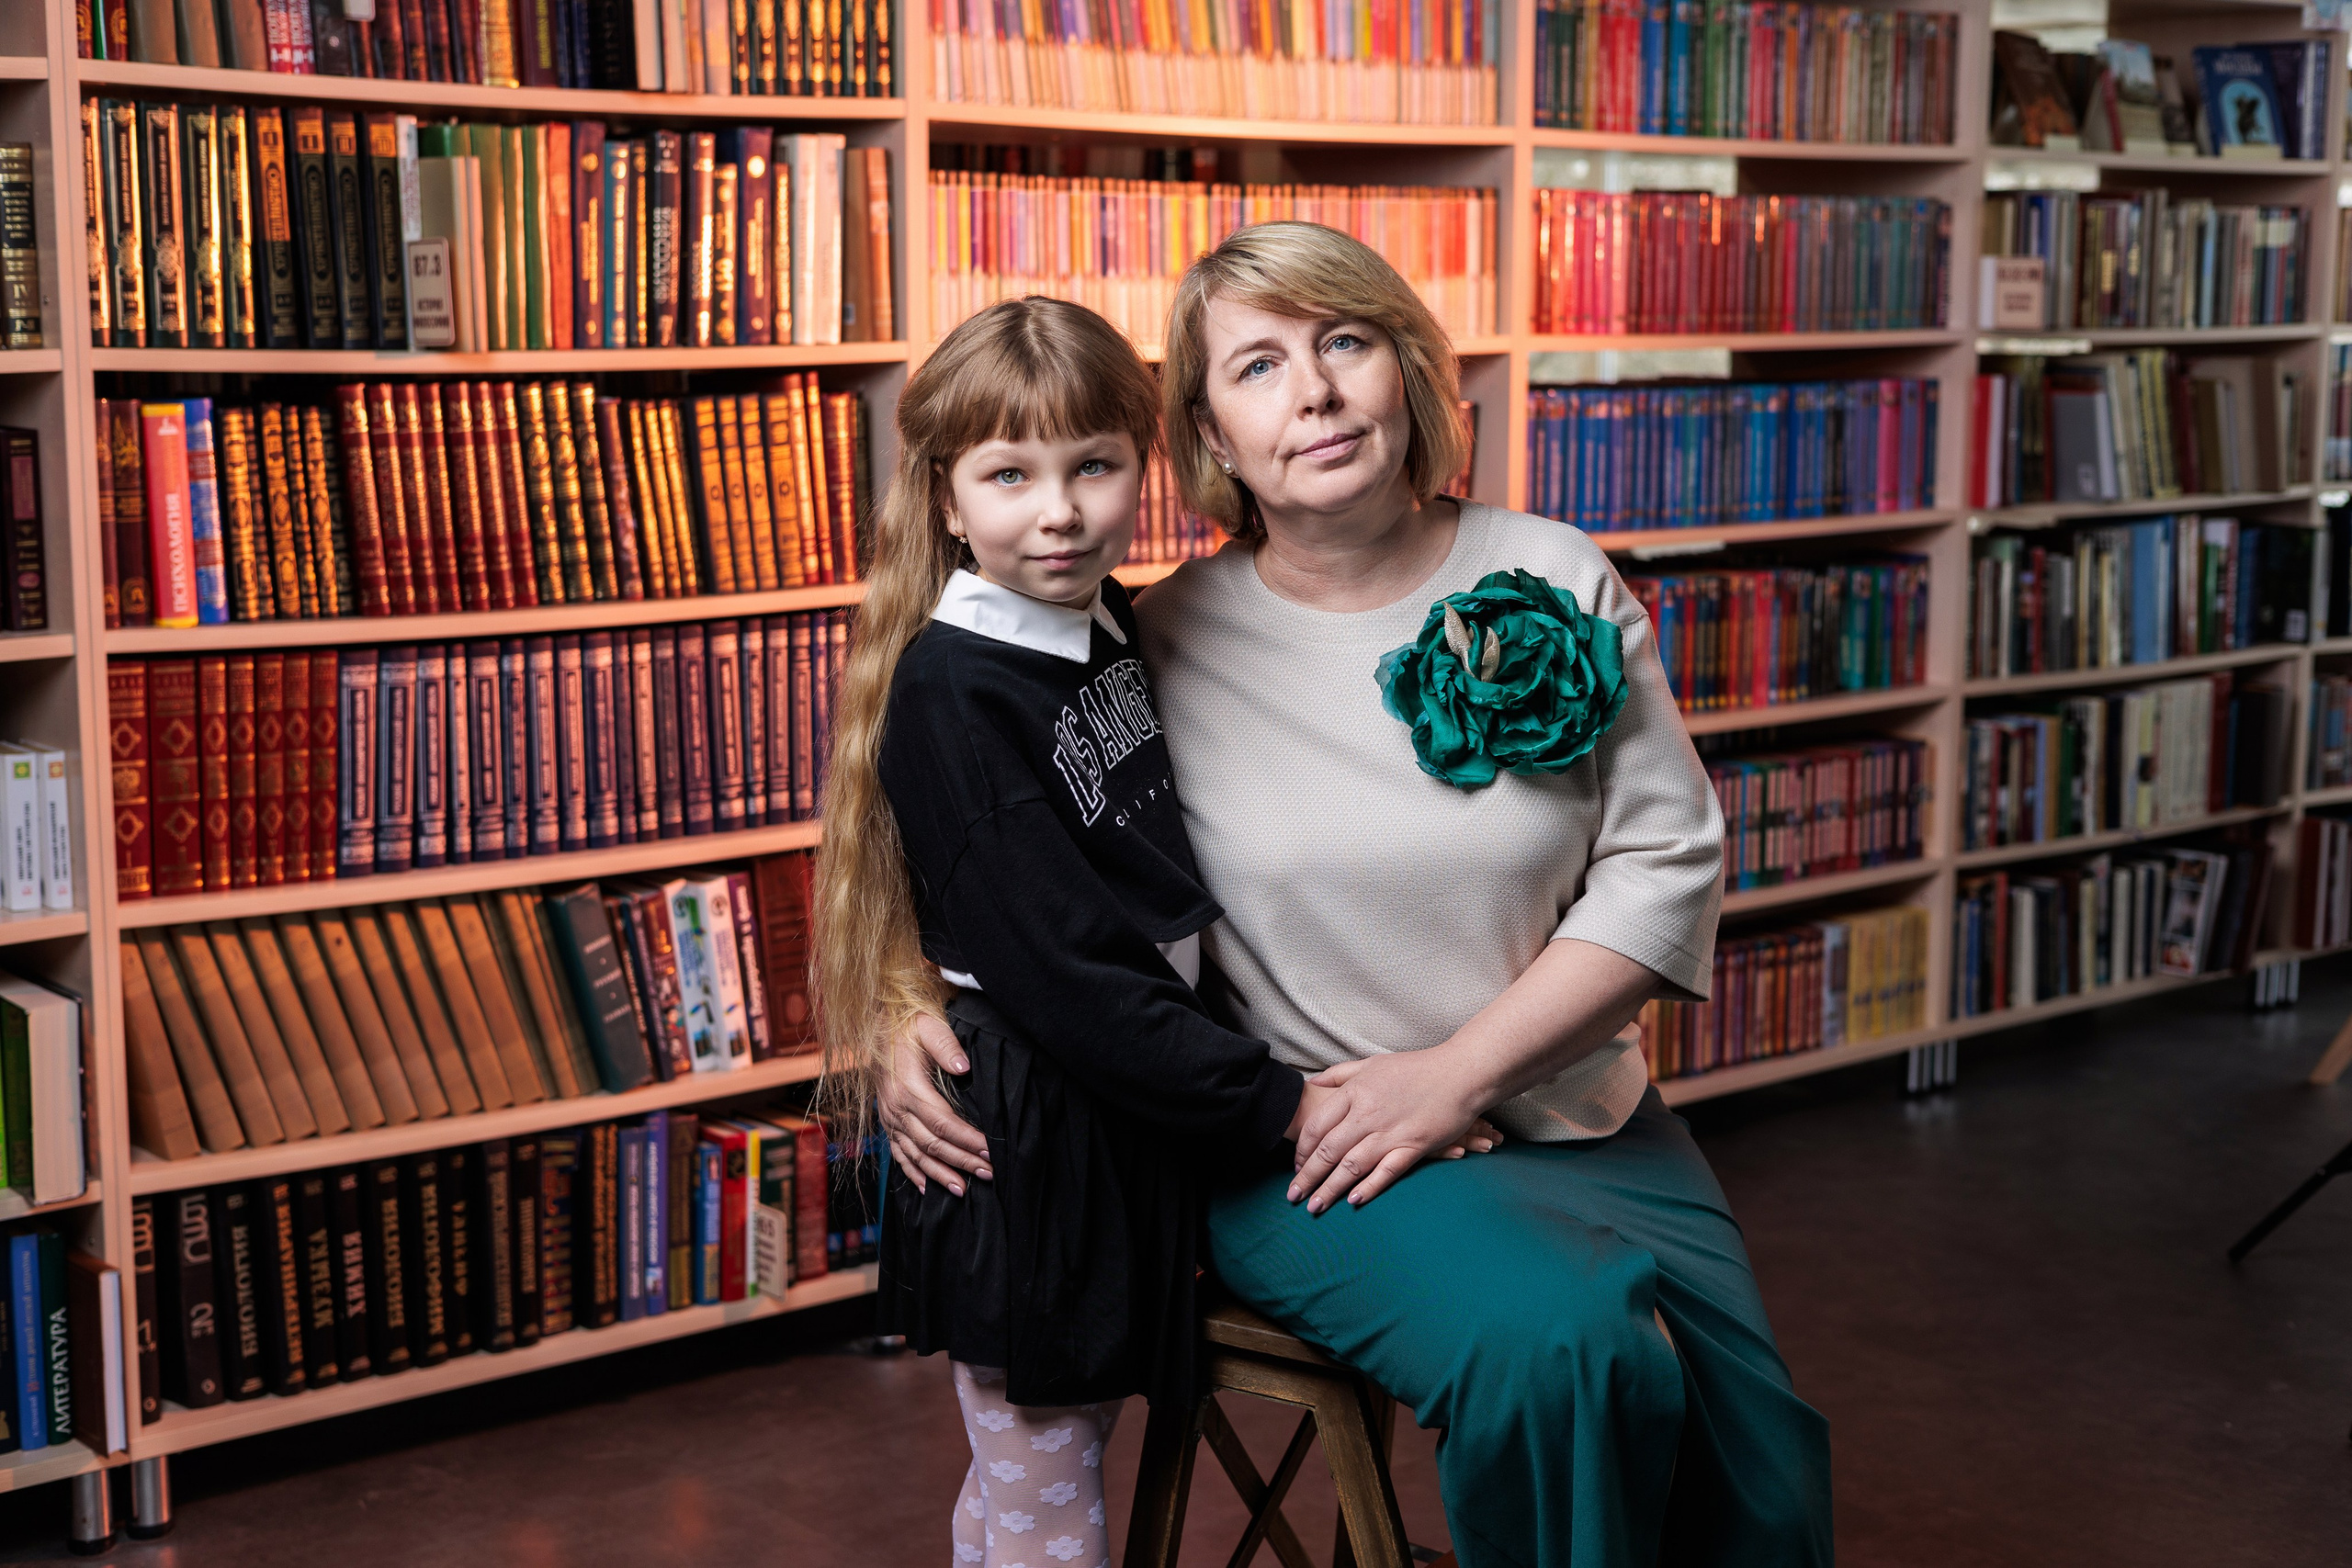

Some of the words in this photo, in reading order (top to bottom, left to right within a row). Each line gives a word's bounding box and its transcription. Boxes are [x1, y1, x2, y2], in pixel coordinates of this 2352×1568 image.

[165, 492, 189, 613] ПСИХОЛОГИЯ
[1079, 659, 1162, 770] ANGE
[231, 1224, 259, 1359] БИОЛОГИЯ
[275, 1202, 303, 1364] ВЕТЕРИНАРИЯ
[308, 1227, 334, 1329] МУЗЫКА
[342, 1230, 367, 1318] ХИМИЯ
[380, 1198, 405, 1329] БИОЛОГИЯ
[420, 1182, 446, 1336] МИФОЛОГИЯ
[451, 1200, 469, 1296] ФИЗИКА
[49, 1306, 73, 1434] ЛИТЕРАТУРА
